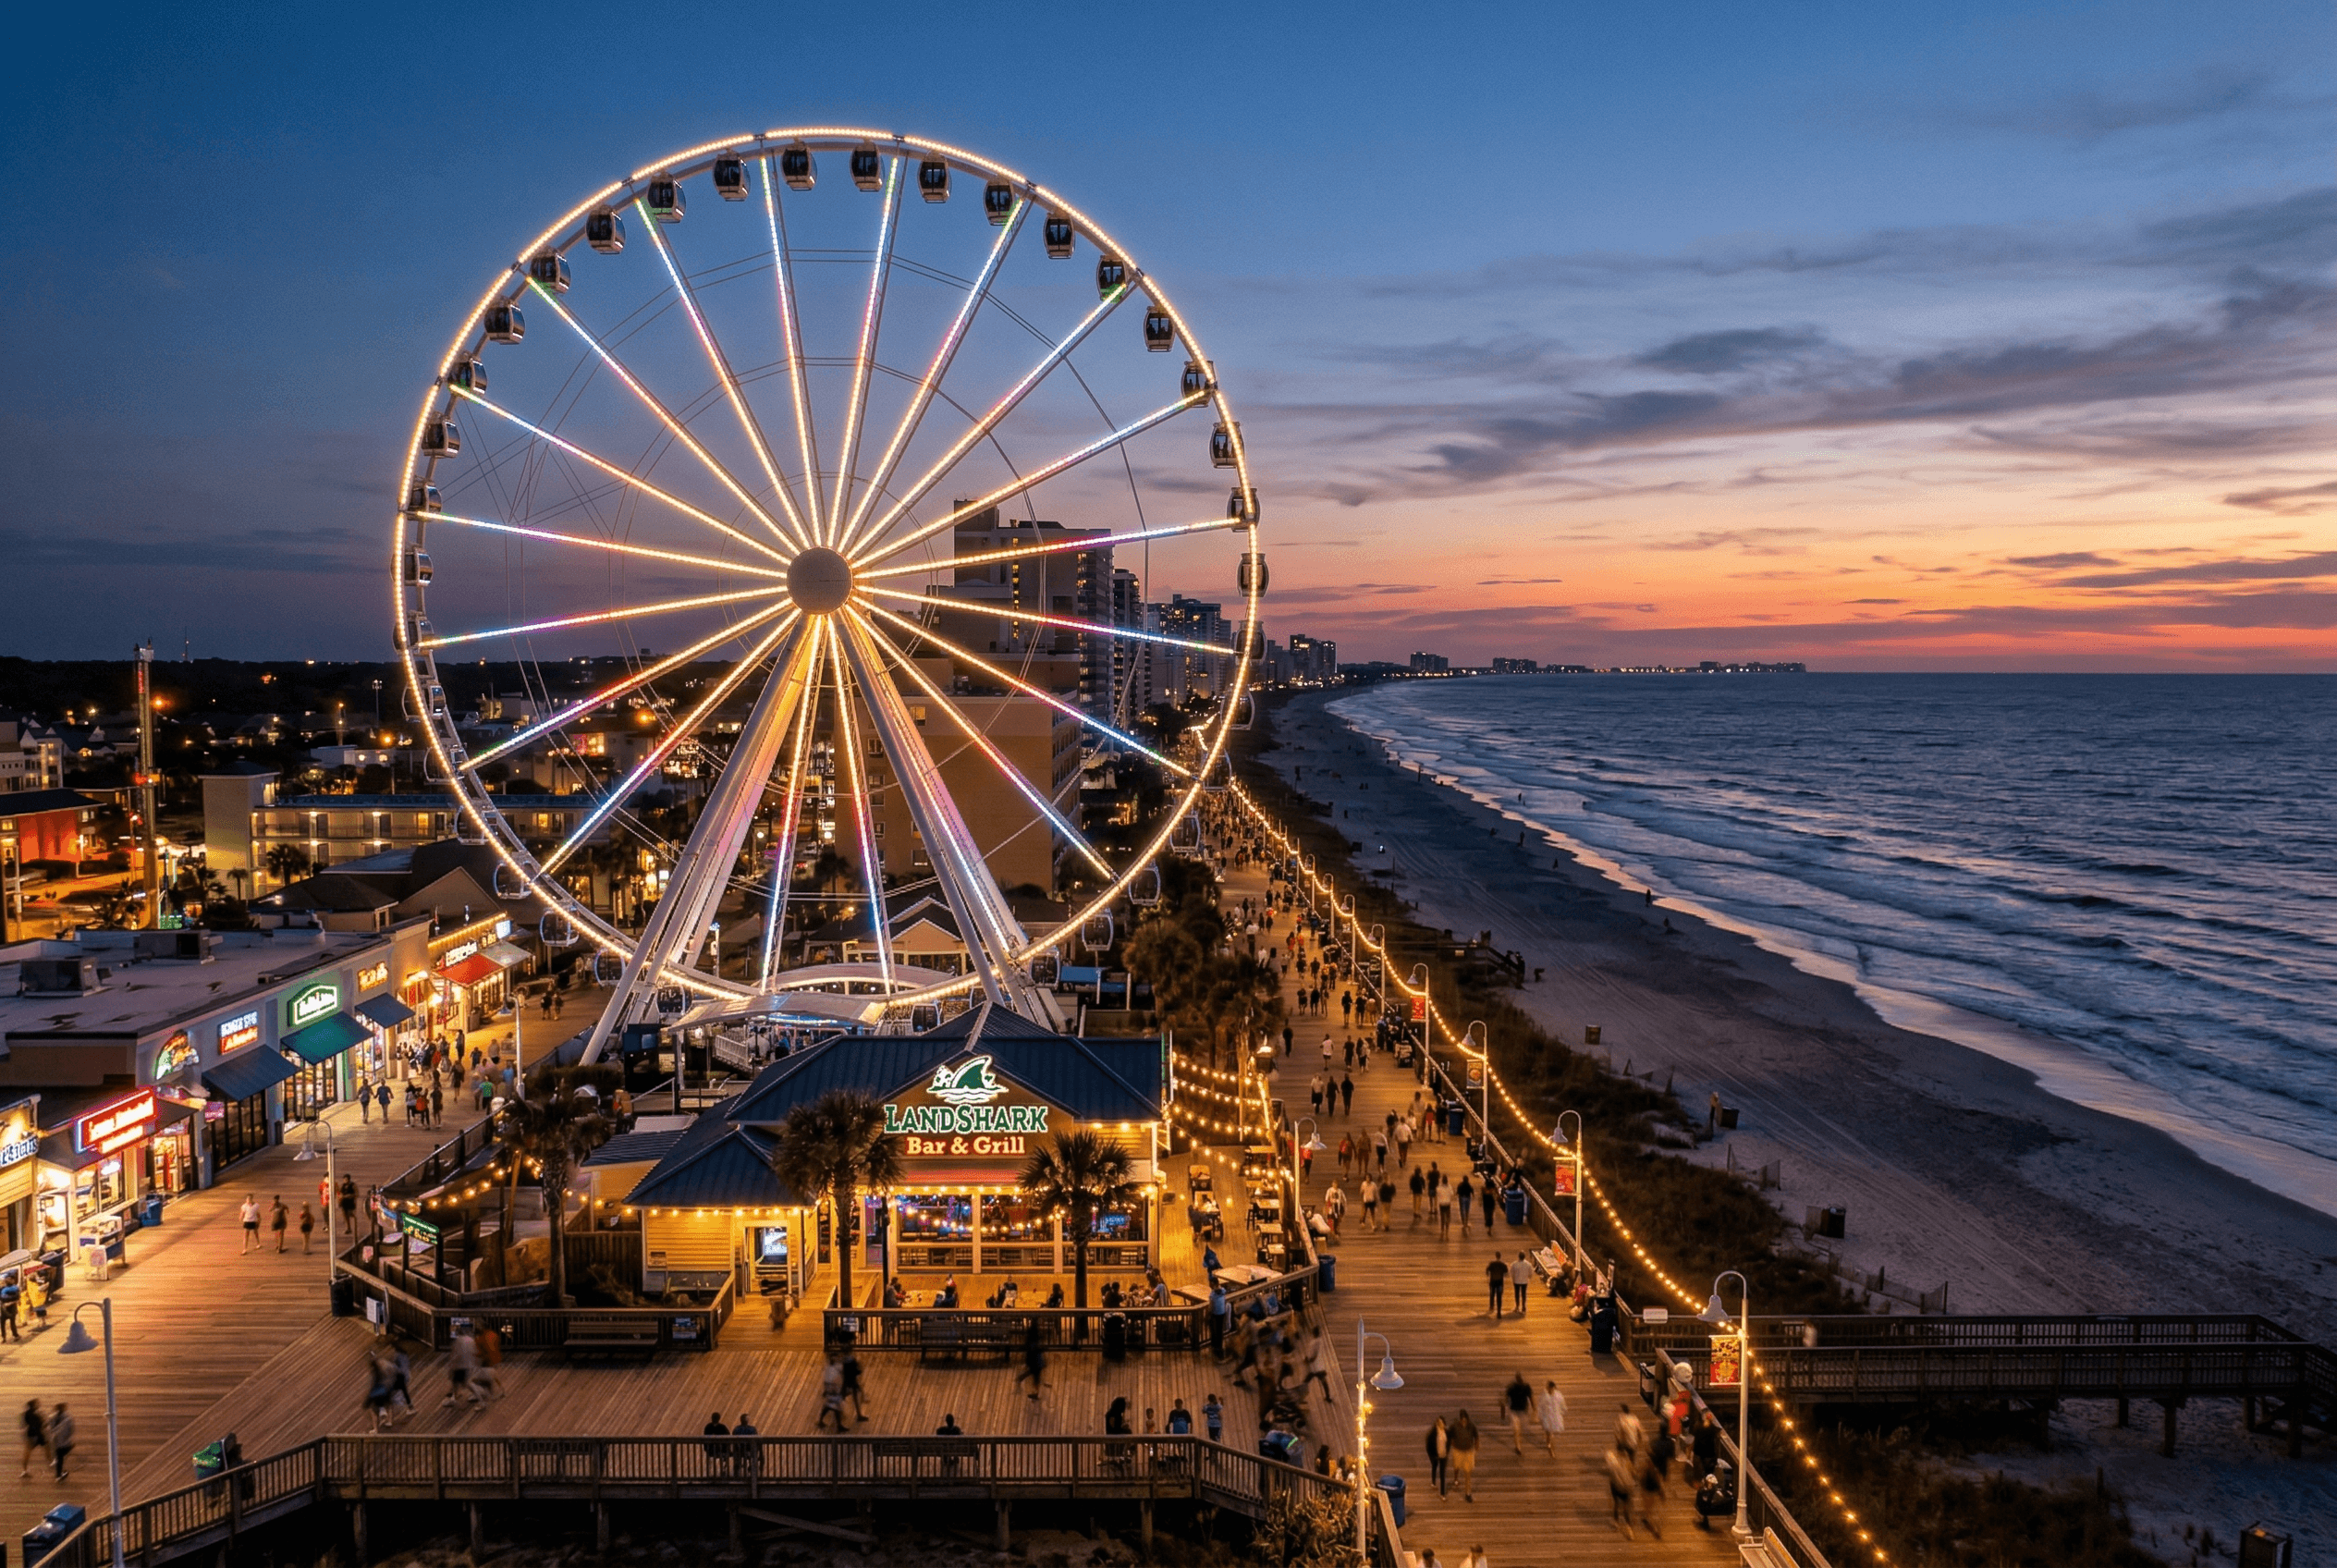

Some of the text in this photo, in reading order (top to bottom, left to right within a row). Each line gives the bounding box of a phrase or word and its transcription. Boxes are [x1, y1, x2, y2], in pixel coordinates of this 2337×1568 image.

[884, 1104, 1048, 1133] LANDSHARK
[906, 1136, 1025, 1155] Bar & Grill
